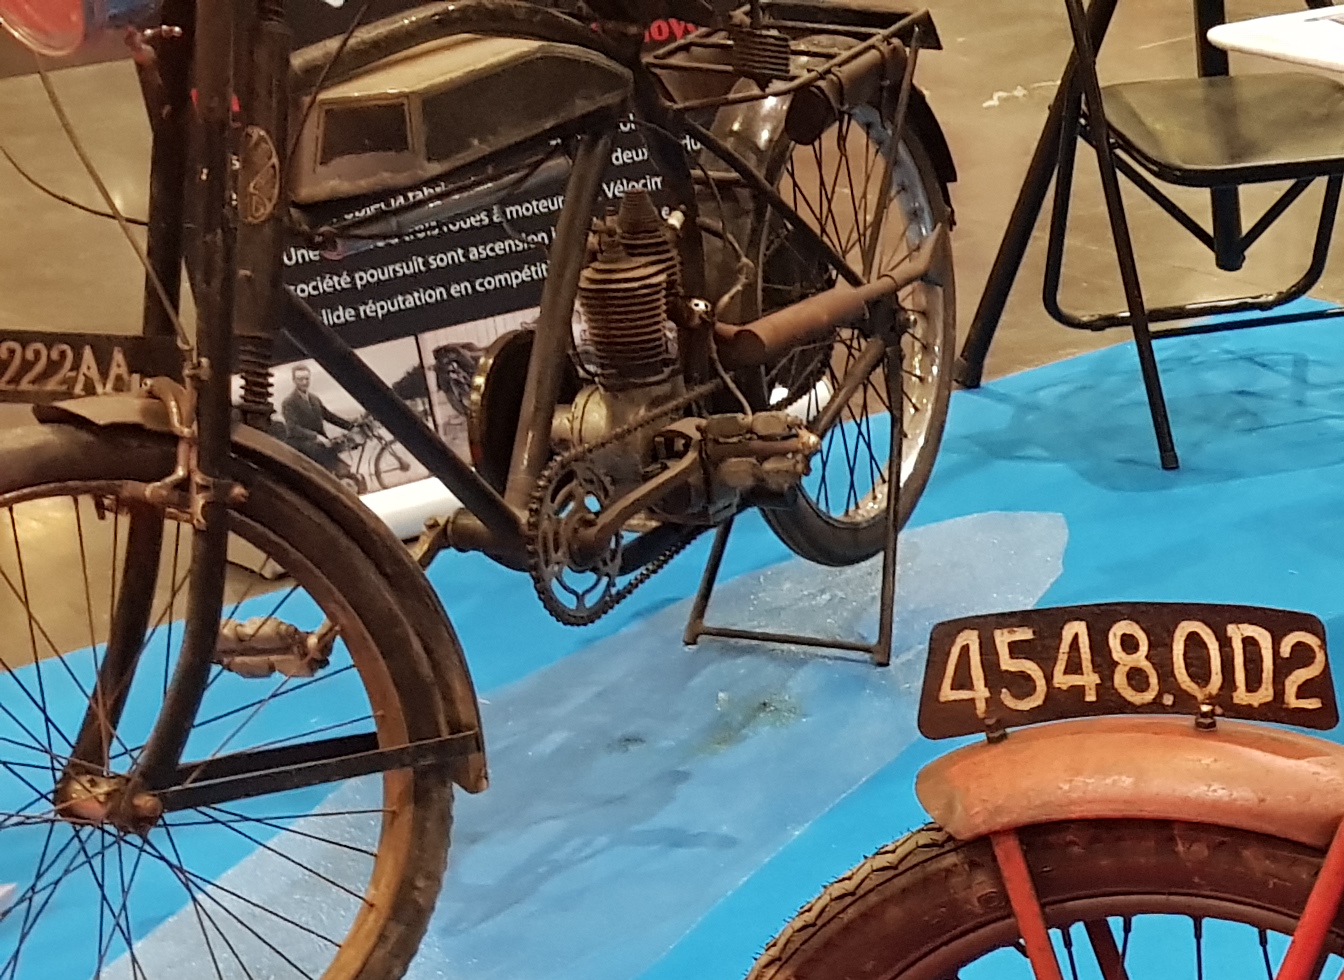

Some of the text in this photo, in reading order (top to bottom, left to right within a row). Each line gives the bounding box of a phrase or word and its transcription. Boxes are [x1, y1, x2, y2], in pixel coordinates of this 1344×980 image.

[354, 256, 427, 290] poursuit
[428, 247, 466, 268] sont
[469, 231, 550, 260] ascension
[359, 287, 447, 320] réputation
[450, 281, 472, 298] en
